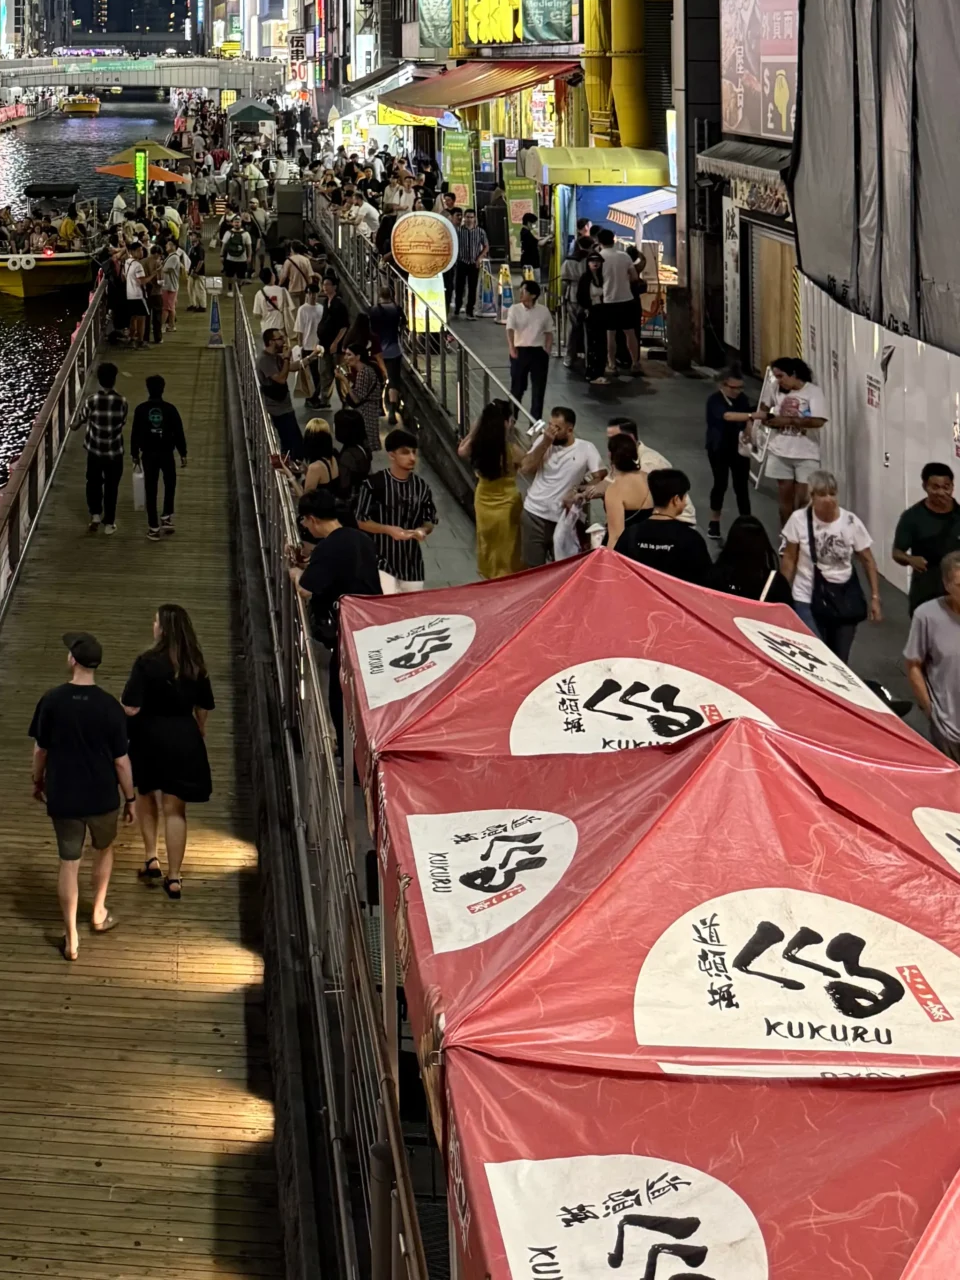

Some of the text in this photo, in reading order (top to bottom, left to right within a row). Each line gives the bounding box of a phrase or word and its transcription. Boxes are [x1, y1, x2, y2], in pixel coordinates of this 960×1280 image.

[368, 648, 384, 675] KUKURU
[389, 627, 453, 669] くくる
[555, 675, 586, 734] 道頓堀
[582, 678, 705, 738] くくる
[601, 737, 672, 750] KUKU
[449, 814, 542, 847] 道頓堀
[427, 851, 453, 895] KUKURU
[458, 831, 548, 894] くくる
[692, 912, 740, 1011] 道頓堀
[732, 920, 906, 1020] くくる
[763, 1016, 894, 1046] KUKURU
[555, 1171, 693, 1228] 道頓堀
[527, 1245, 564, 1280] KU
[606, 1214, 709, 1280] くく
